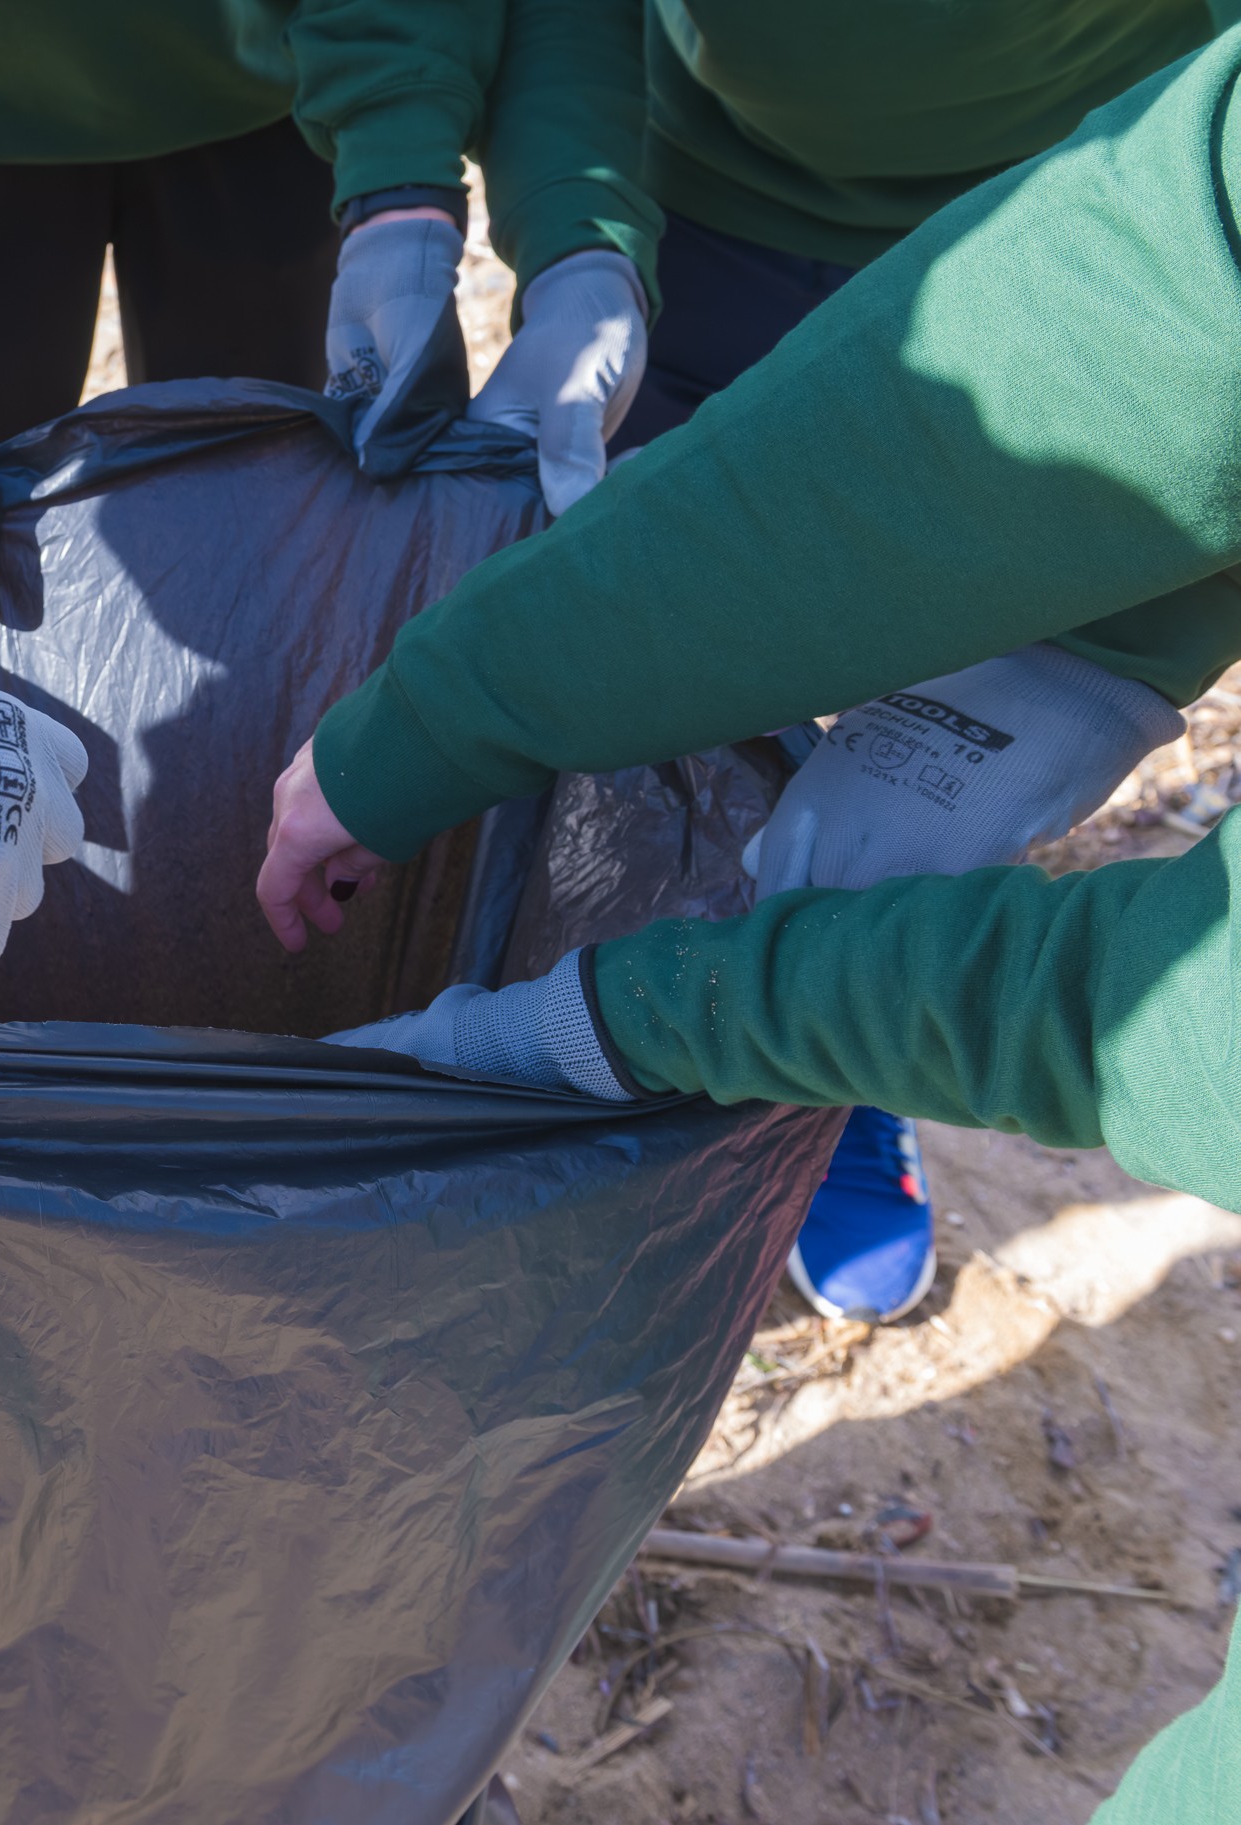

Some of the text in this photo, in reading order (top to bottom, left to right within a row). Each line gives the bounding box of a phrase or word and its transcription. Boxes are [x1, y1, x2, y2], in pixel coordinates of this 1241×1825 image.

[886, 695, 990, 743] TOOLS
[827, 725, 864, 752] CE
[953, 743, 984, 765] 10
[4, 803, 22, 846] CE
